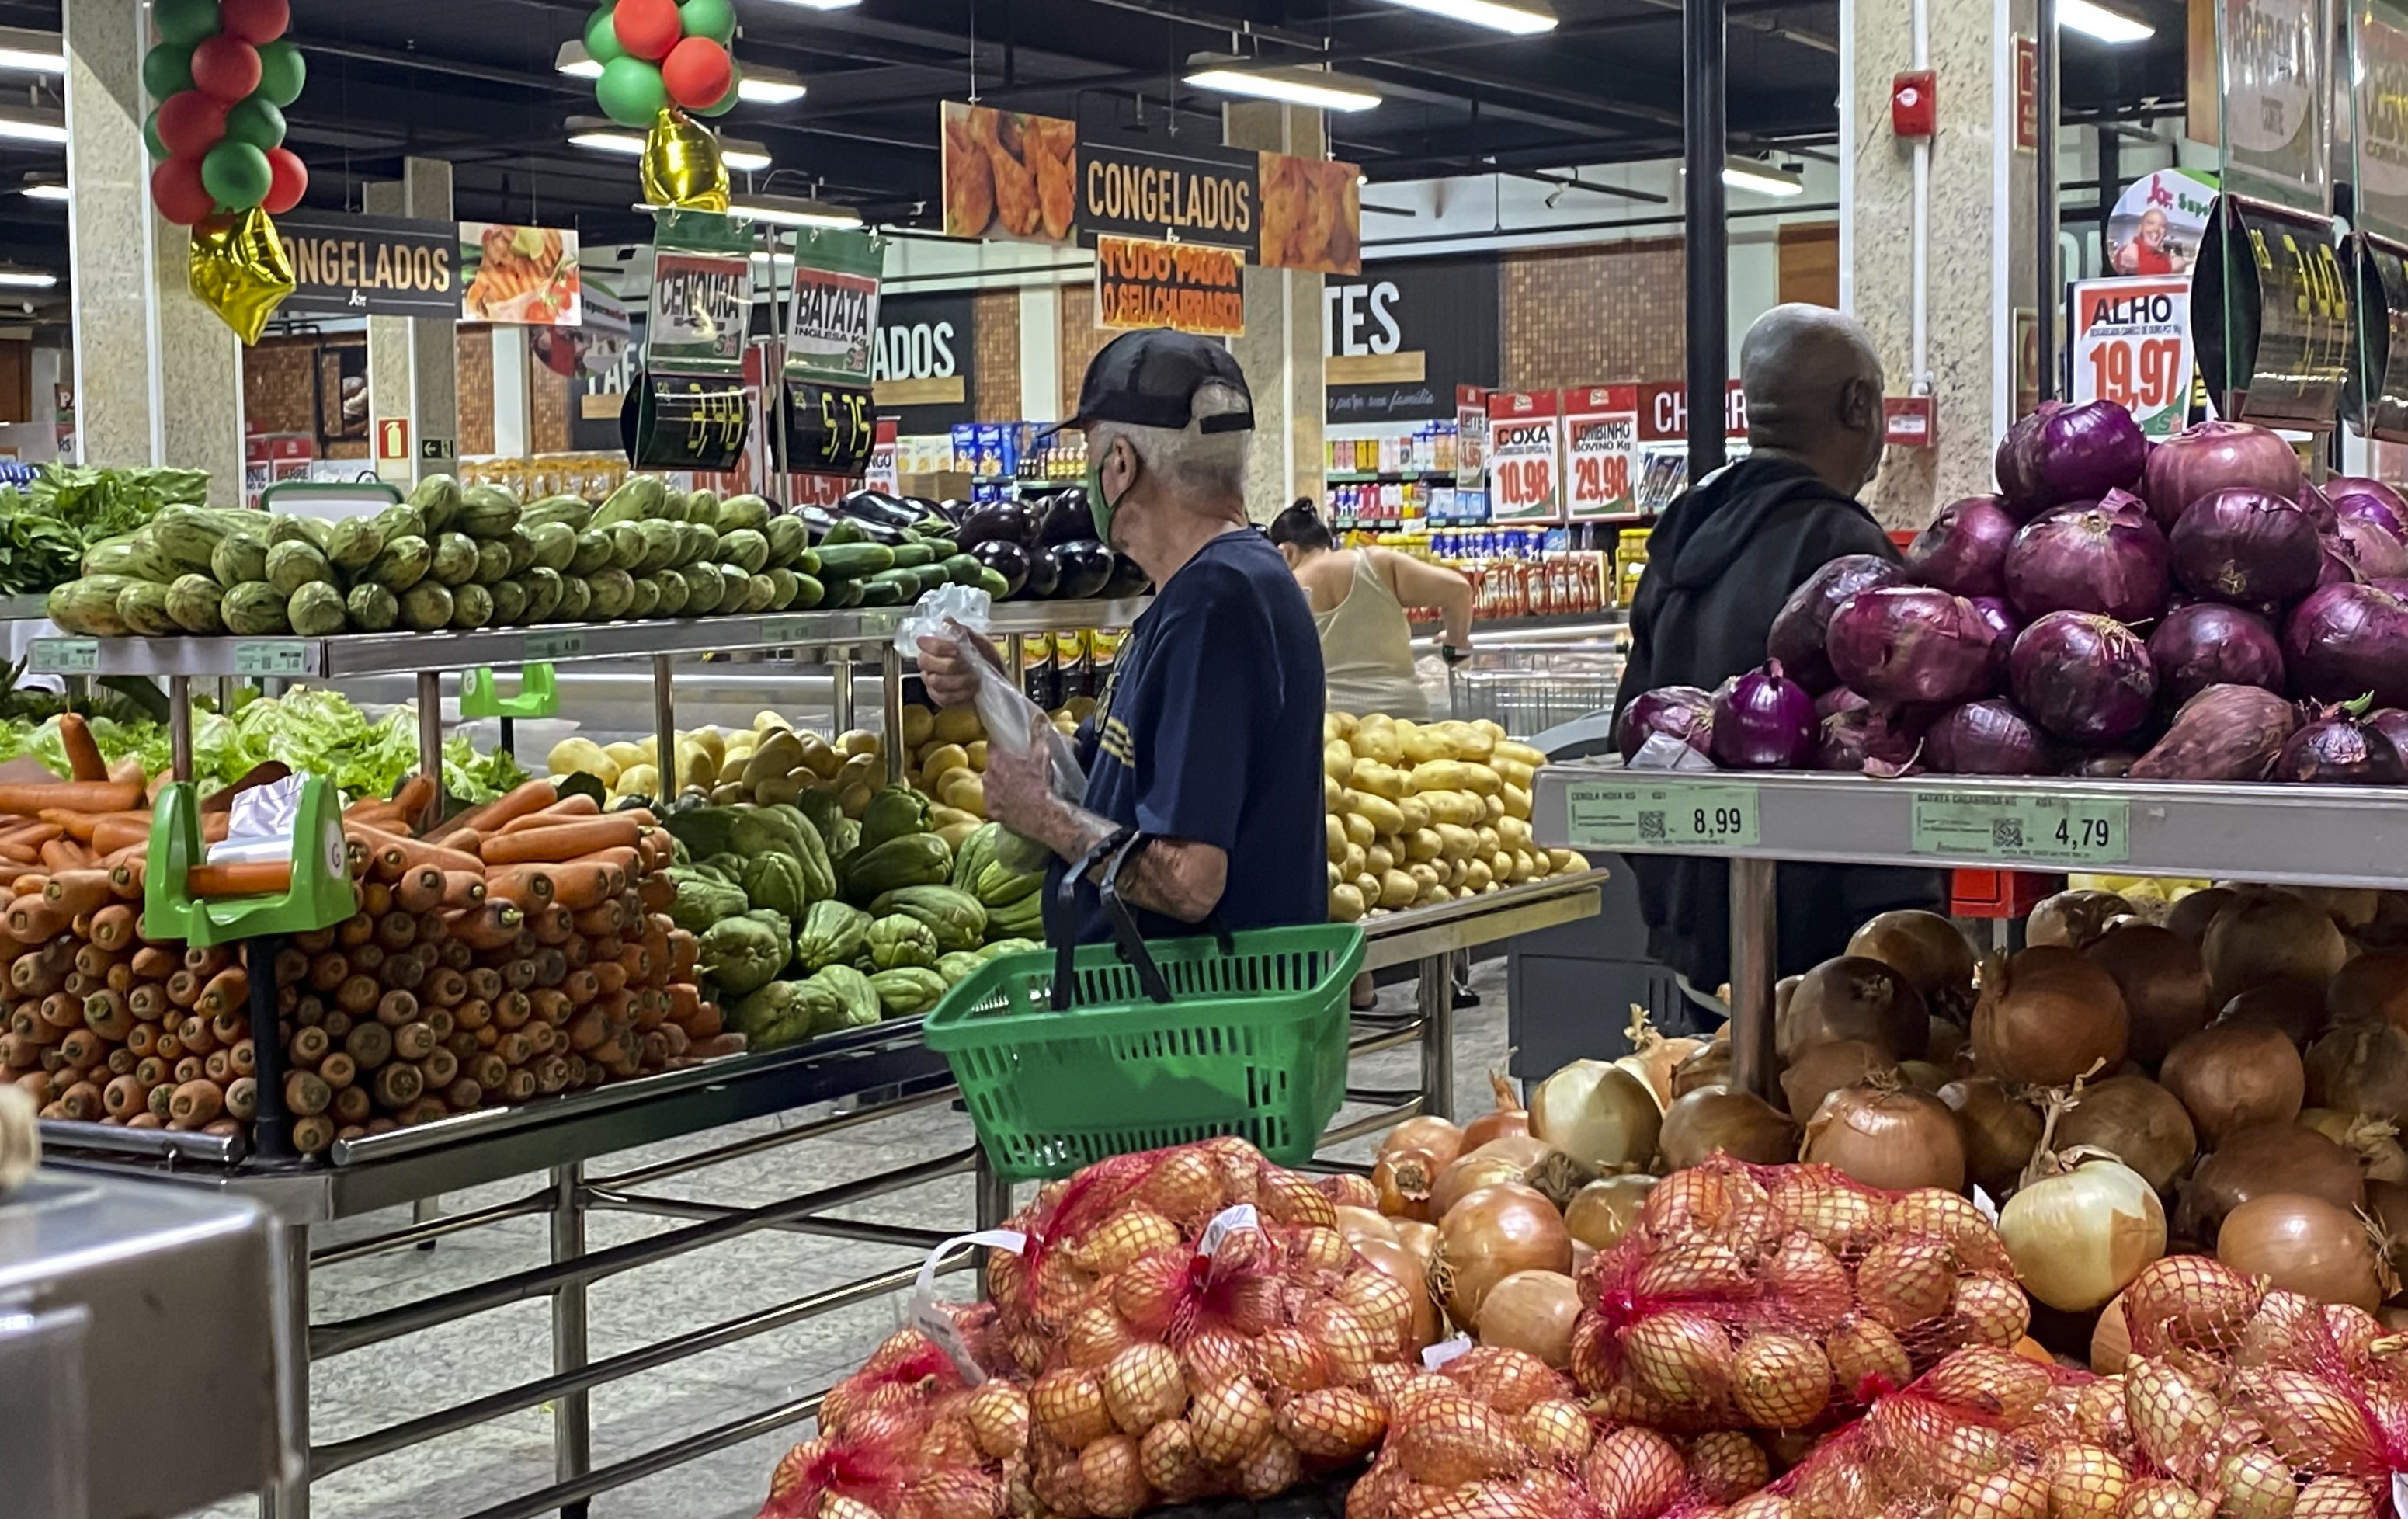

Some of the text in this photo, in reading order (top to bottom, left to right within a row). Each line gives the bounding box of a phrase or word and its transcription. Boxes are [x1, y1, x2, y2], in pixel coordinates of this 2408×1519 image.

[1088, 160, 1250, 232] CONGELADOS
[1100, 244, 1237, 287] TUDO PARA
[660, 266, 739, 319] CENOURA
[797, 280, 868, 335] BATATA
[1103, 282, 1242, 330] O SEU CHURRASCO
[2092, 294, 2173, 325] ALHO
[795, 326, 867, 348] INGLESA Kg
[2090, 339, 2181, 413] 19,97
[1497, 426, 1551, 446] COXA
[1573, 422, 1631, 442] LOMBINHO
[1573, 442, 1631, 452] BOVINO Kg
[1497, 459, 1551, 508] 10,98
[1575, 455, 1630, 505] 29,98
[1694, 808, 1742, 838] 8,99
[2055, 818, 2109, 850] 4,79
